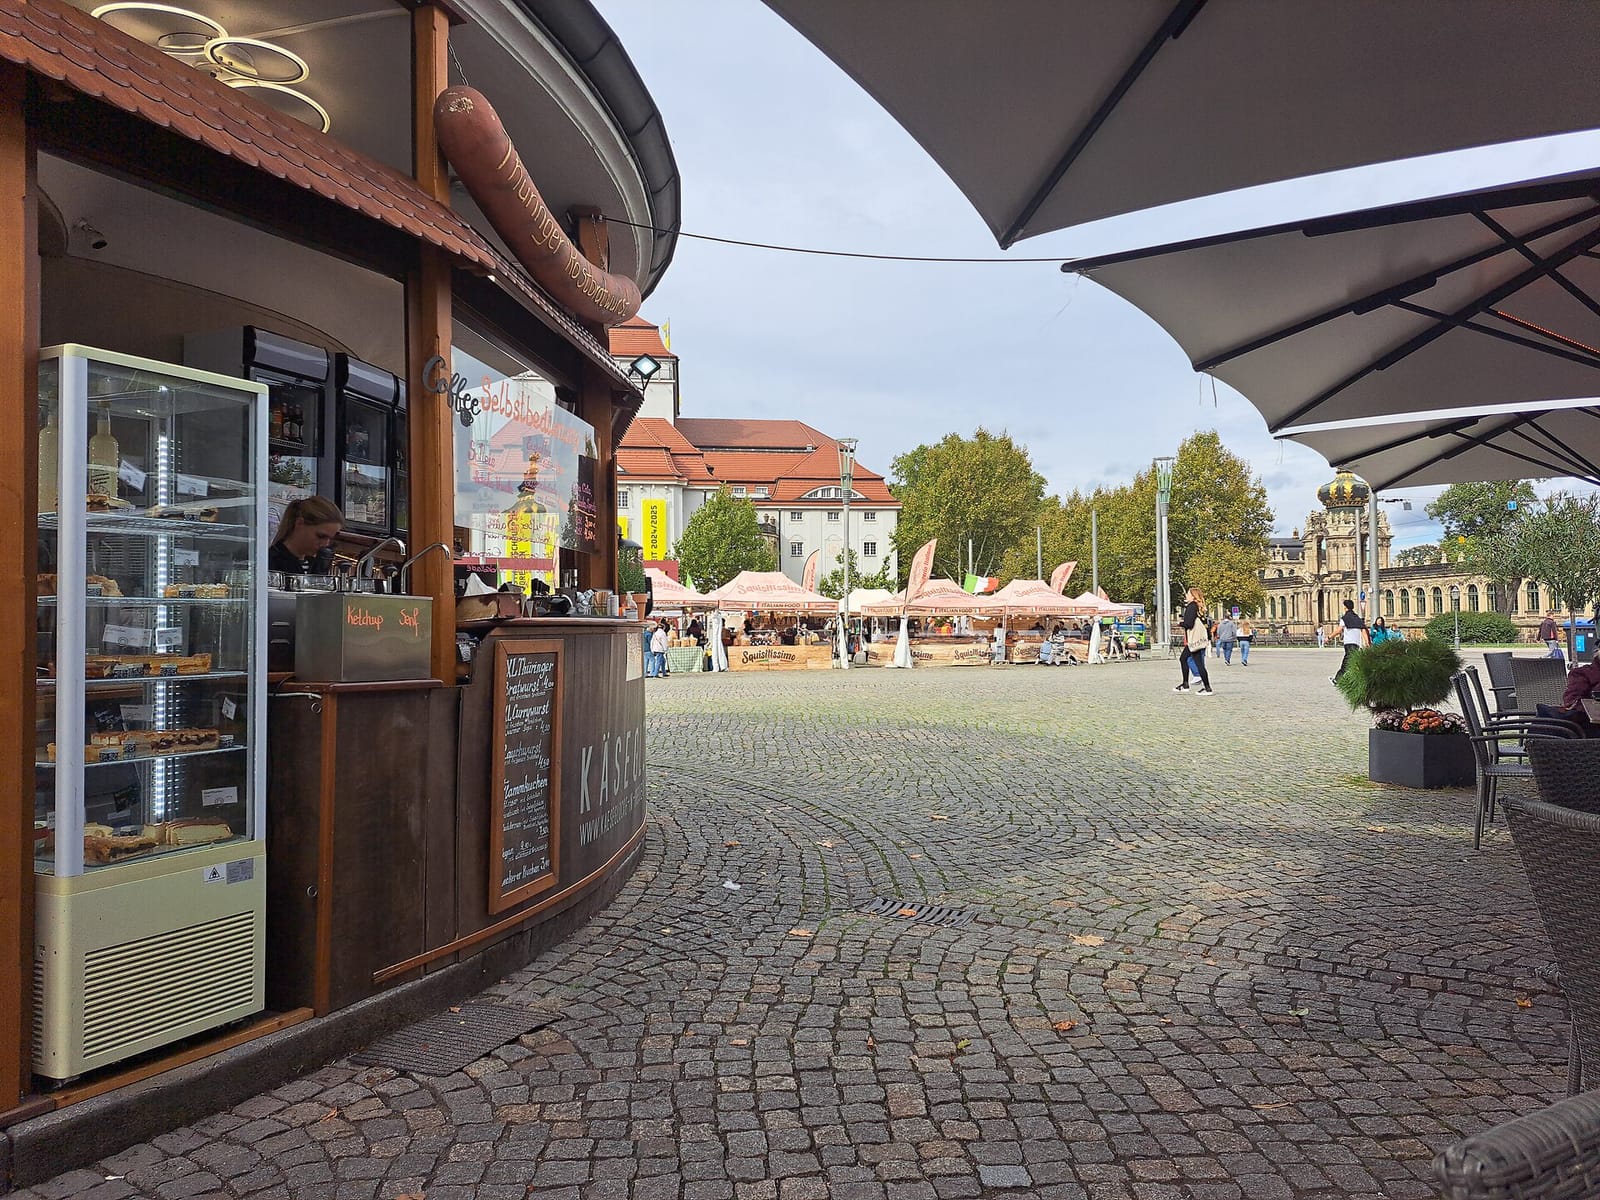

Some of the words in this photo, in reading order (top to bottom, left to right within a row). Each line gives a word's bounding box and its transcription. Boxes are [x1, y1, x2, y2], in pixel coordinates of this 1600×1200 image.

[422, 355, 482, 416] Coffee
[650, 504, 658, 550] 2024/2025
[347, 604, 384, 631] Ketchup
[399, 607, 419, 637] Senf
[518, 657, 554, 680] Thüringer
[742, 647, 796, 664] Squisitissimo
[511, 699, 549, 723] Currywurst
[579, 727, 645, 815] KÄSEGL
